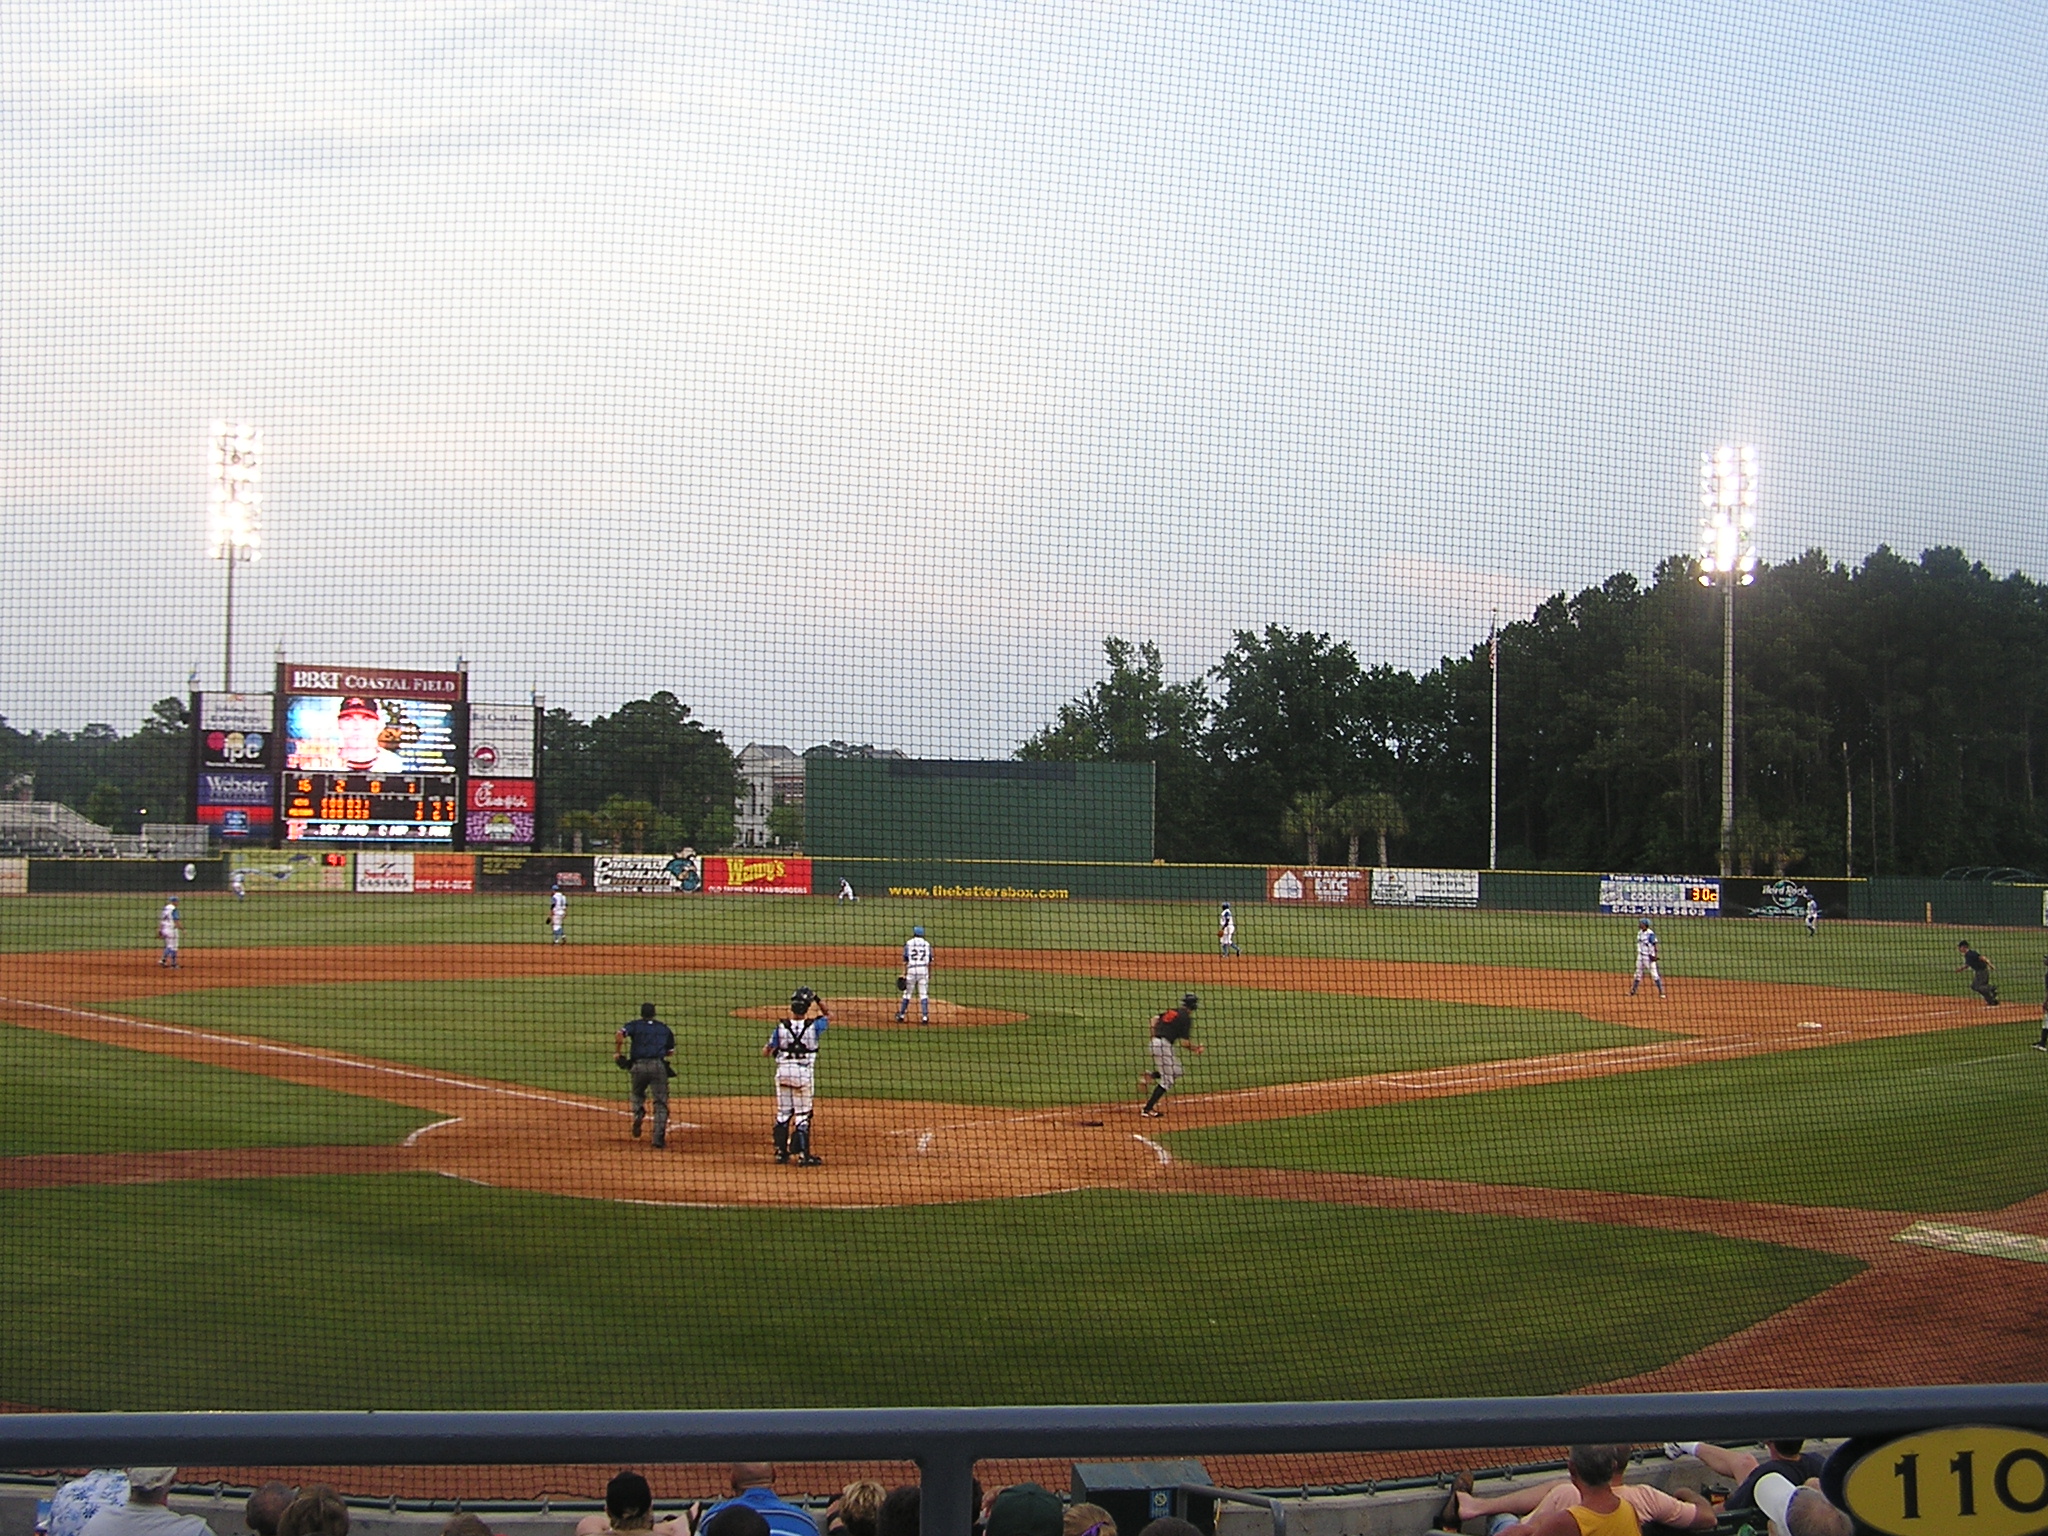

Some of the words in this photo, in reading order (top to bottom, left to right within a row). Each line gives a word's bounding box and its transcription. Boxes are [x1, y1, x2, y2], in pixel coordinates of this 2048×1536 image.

[293, 671, 343, 690] BB&T
[345, 675, 410, 691] COASTAL
[413, 677, 455, 692] FIELD
[223, 737, 260, 763] ipc
[206, 775, 269, 792] Webster
[598, 858, 667, 872] COASTAL
[599, 870, 671, 885] CAROLINA
[1762, 884, 1785, 895] Hard
[911, 949, 927, 961] 27
[1894, 1448, 2048, 1519] 110
